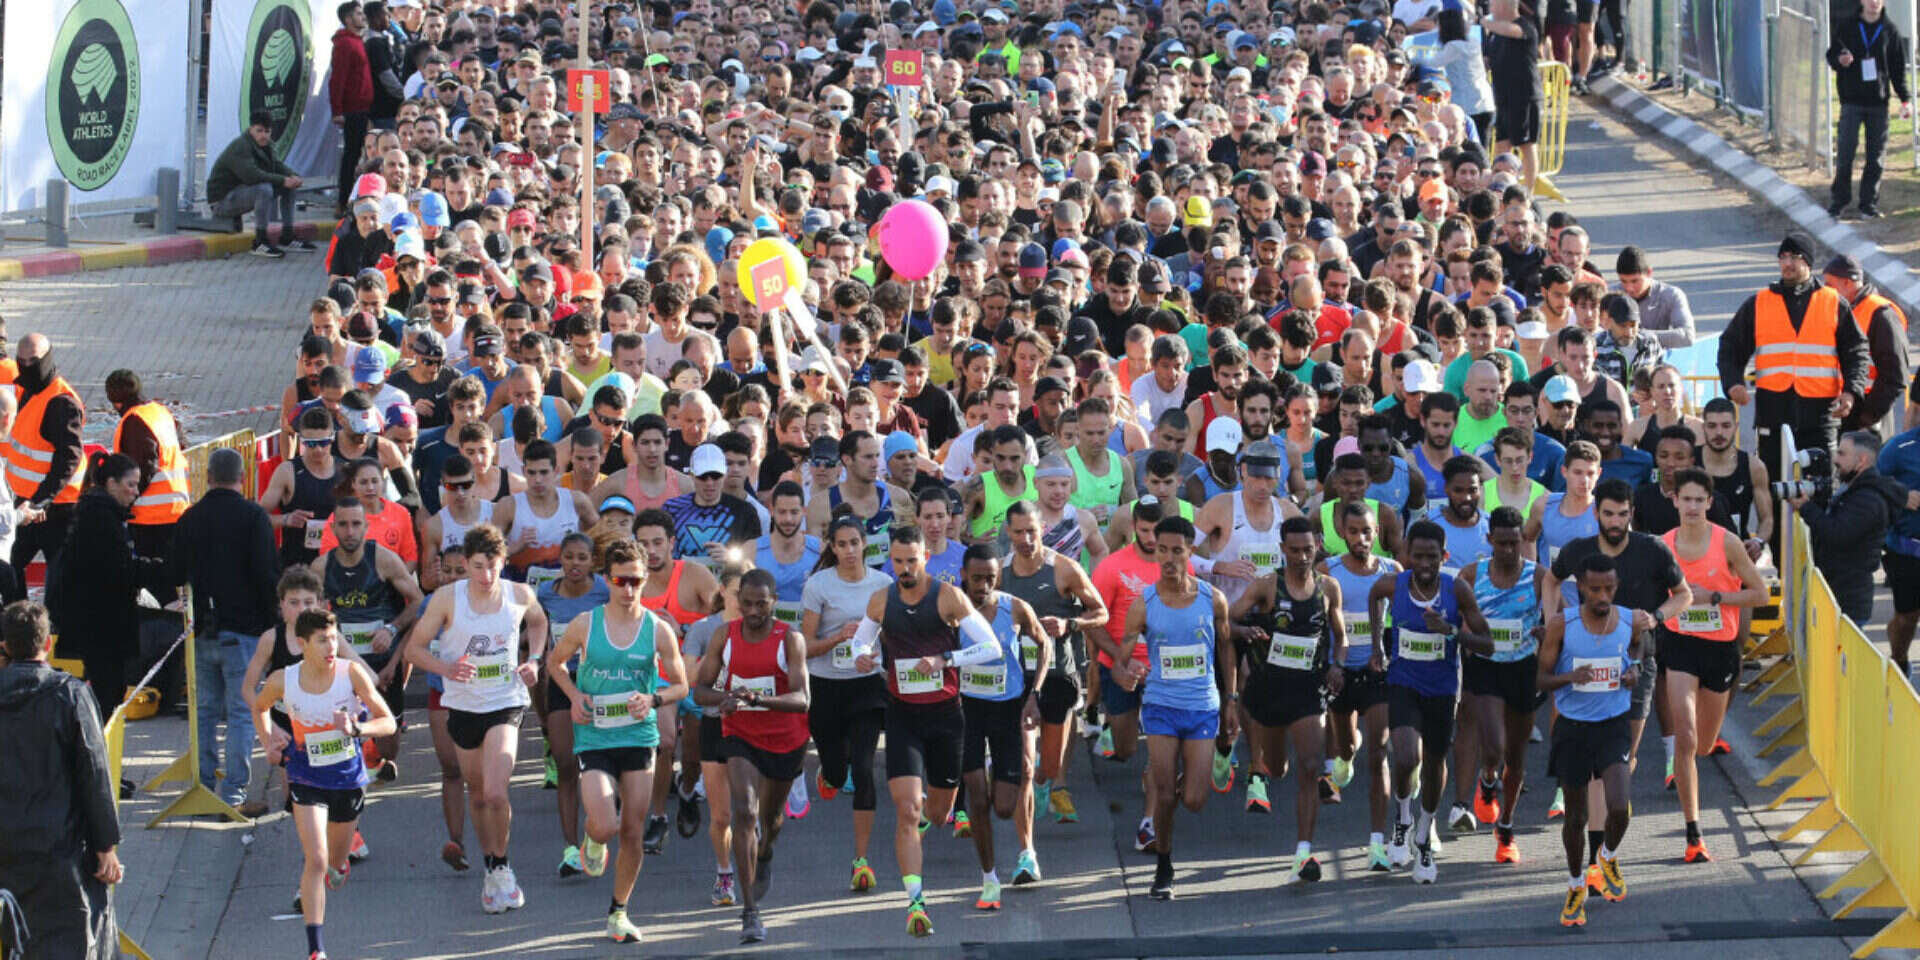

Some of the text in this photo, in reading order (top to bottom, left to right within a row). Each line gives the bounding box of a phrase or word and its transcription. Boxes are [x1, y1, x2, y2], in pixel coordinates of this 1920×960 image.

[892, 61, 915, 75] 60
[79, 110, 108, 124] WORLD
[73, 125, 113, 140] ATHLETICS
[762, 274, 783, 297] 50
